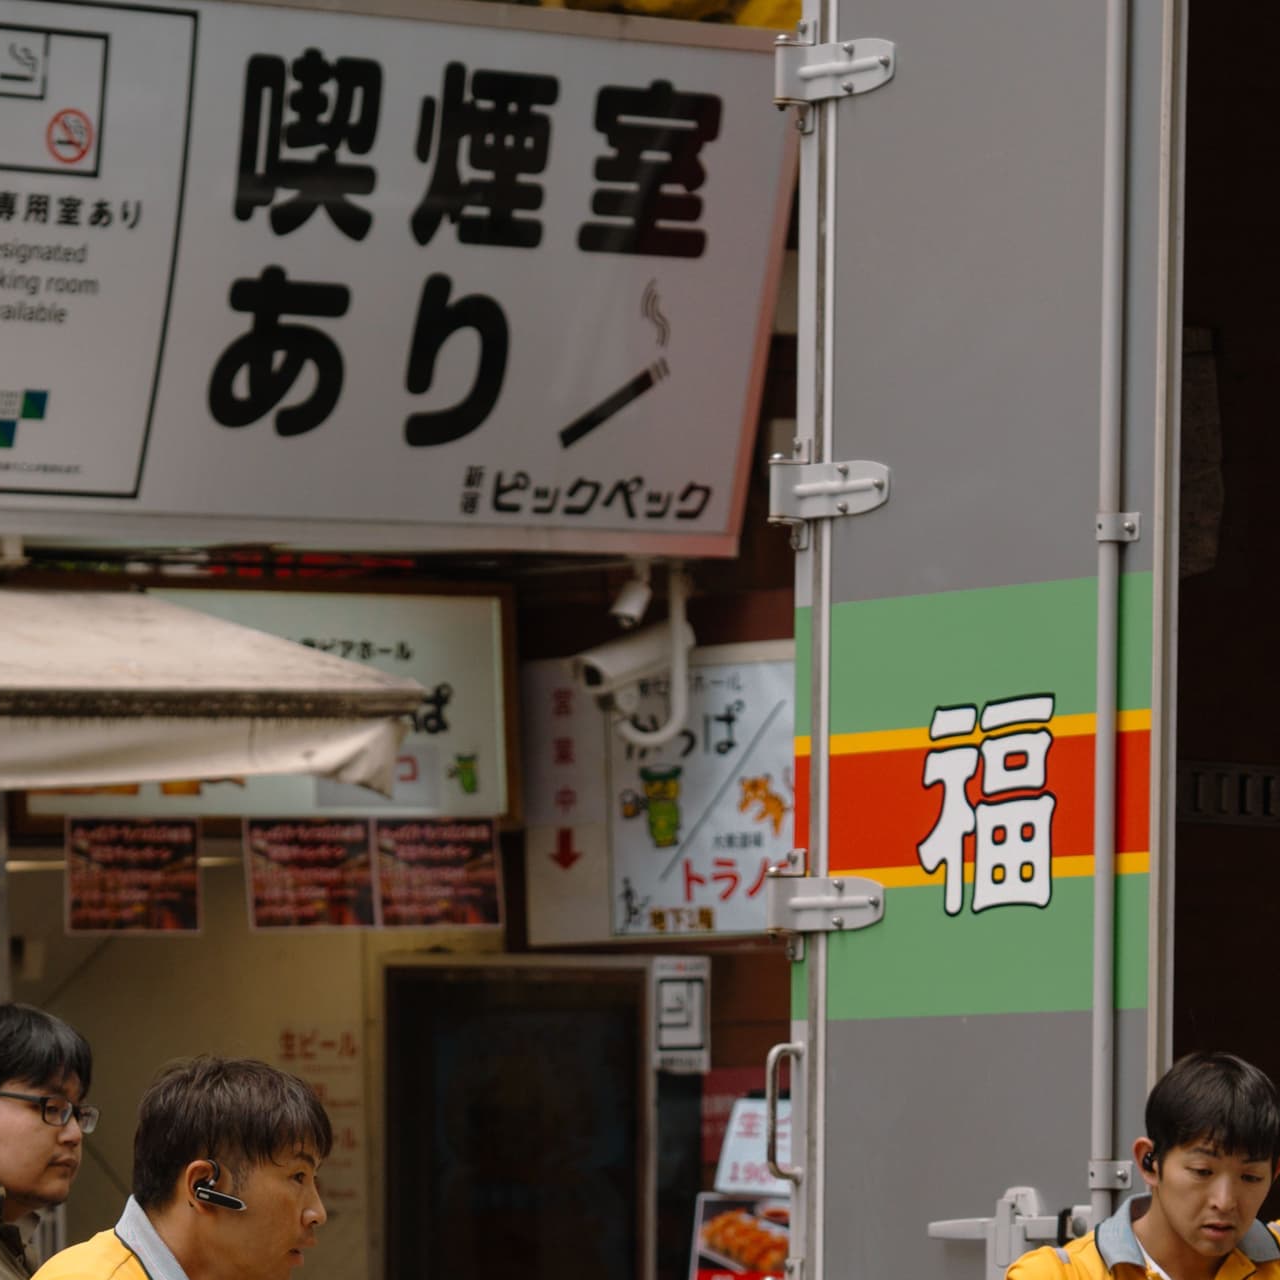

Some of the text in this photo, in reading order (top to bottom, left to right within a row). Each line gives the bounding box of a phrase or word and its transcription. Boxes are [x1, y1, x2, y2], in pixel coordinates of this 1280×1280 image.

[232, 47, 724, 260] 喫煙室
[45, 274, 99, 296] room
[206, 265, 512, 449] あり
[491, 471, 713, 520] ピックペック
[552, 687, 577, 813] 営業中
[916, 691, 1057, 917] 福
[683, 857, 789, 902] トラノ
